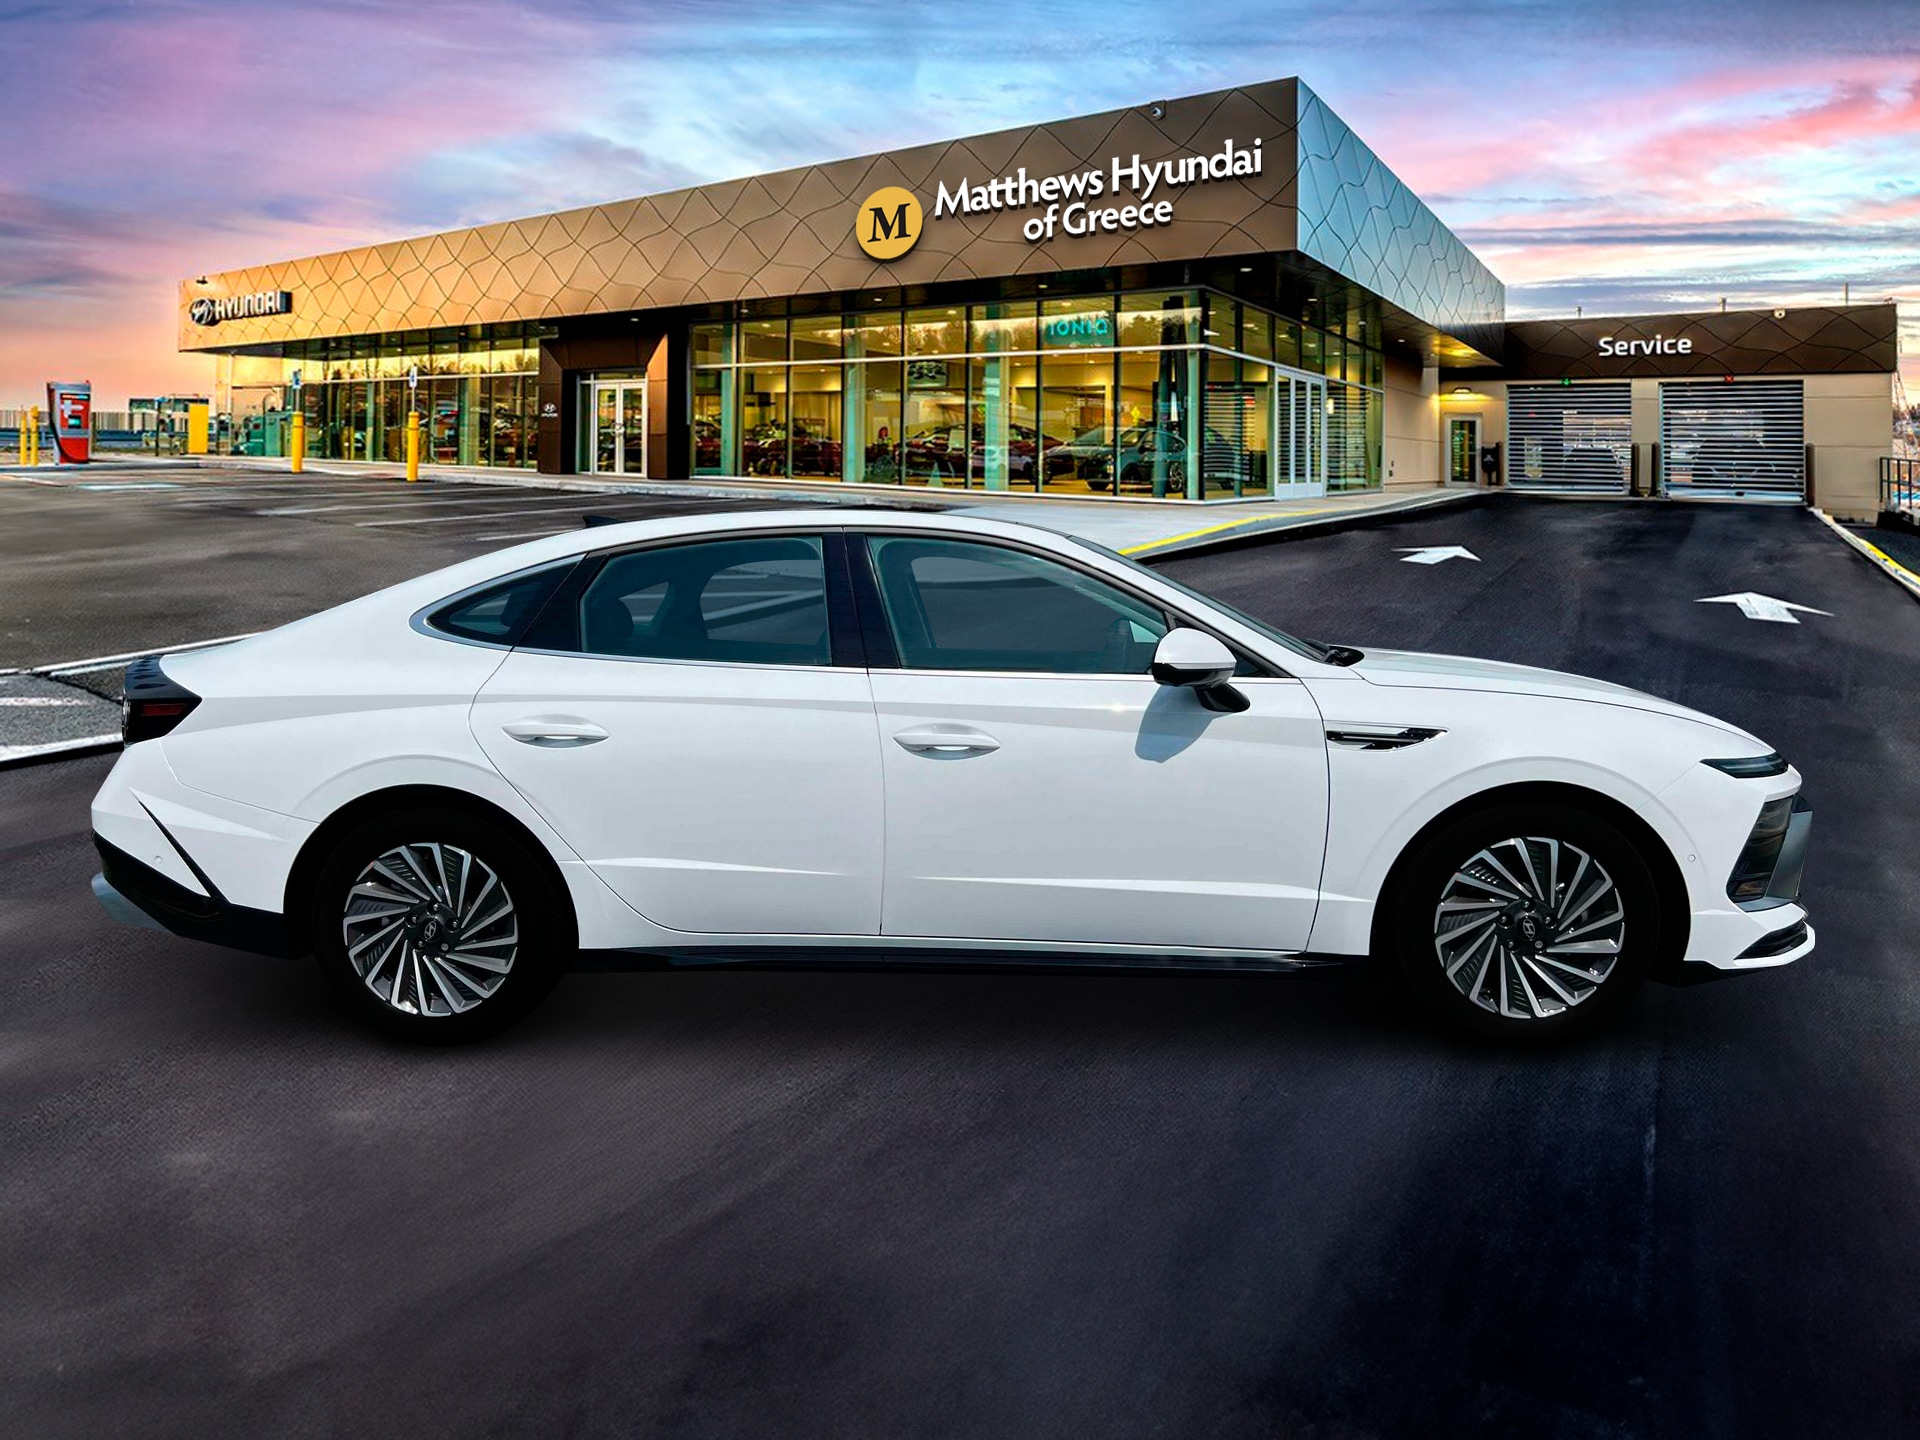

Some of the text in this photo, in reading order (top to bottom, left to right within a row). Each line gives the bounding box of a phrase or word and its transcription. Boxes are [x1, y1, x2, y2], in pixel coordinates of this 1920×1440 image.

[934, 137, 1263, 217] Matthews Hyundai
[867, 202, 911, 243] M
[1023, 200, 1173, 242] of Greece
[214, 291, 281, 320] HYUNDAI
[1598, 334, 1693, 357] Service
